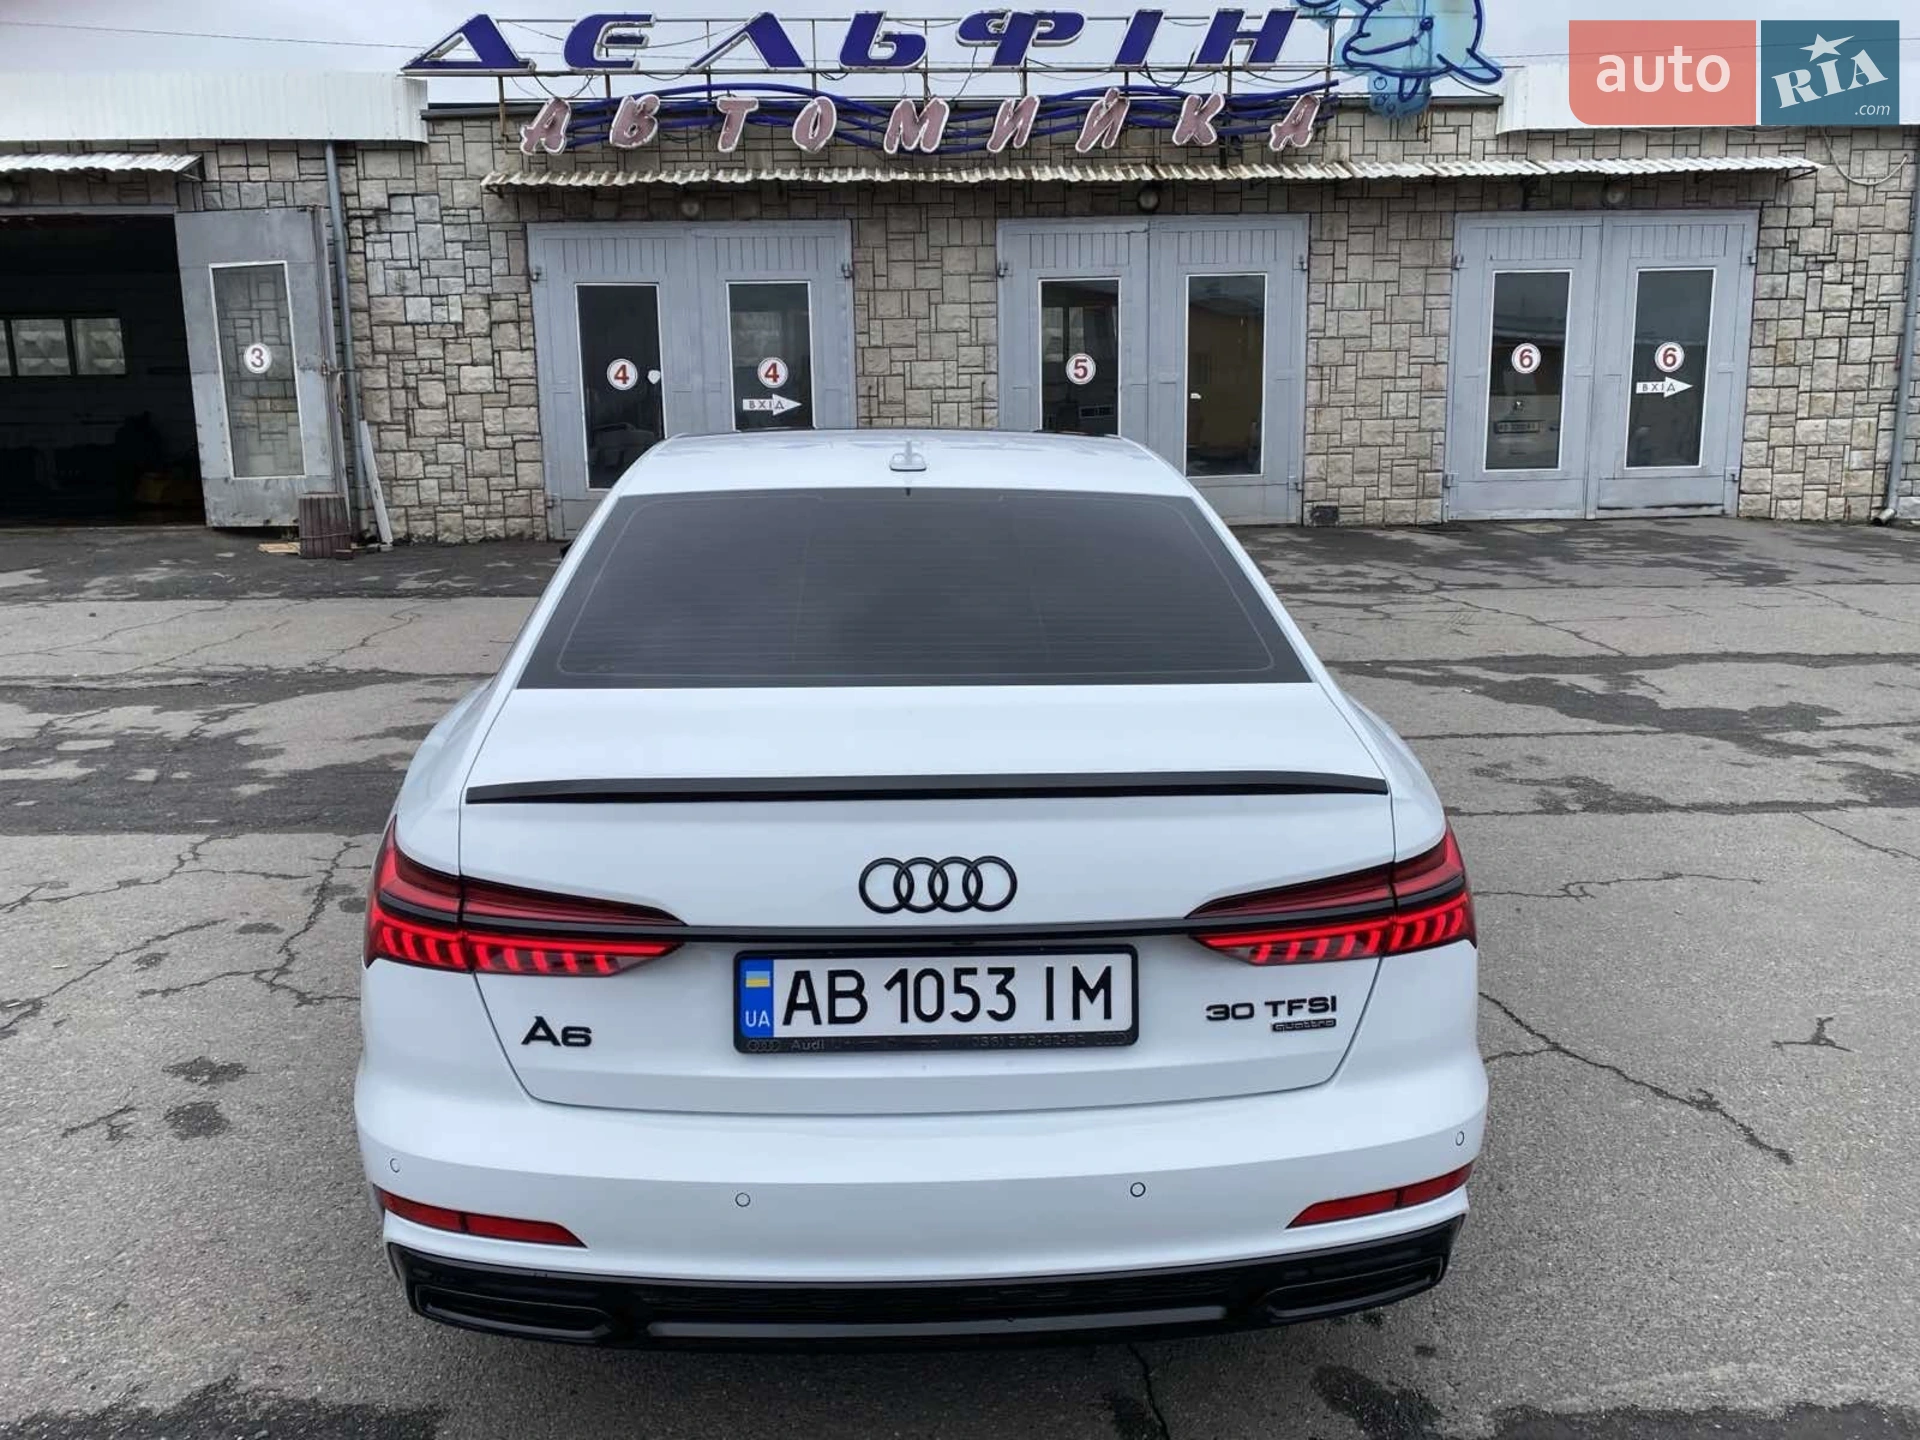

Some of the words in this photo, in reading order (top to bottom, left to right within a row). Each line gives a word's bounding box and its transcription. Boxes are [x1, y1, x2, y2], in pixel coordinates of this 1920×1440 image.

[401, 8, 1301, 73] ДЕЛЬФІН
[520, 87, 1319, 155] АВТОМИЙКА
[250, 347, 264, 368] 3
[1518, 348, 1533, 368] 6
[1662, 347, 1677, 367] 6
[613, 364, 630, 385] 4
[764, 362, 780, 383] 4
[1073, 358, 1088, 379] 5
[1642, 382, 1677, 393] ВХІД
[748, 399, 785, 410] ВХІД
[782, 970, 869, 1026] AB
[883, 966, 1016, 1024] 1053
[1045, 965, 1113, 1021] IM
[1205, 1002, 1255, 1021] 30
[1263, 995, 1337, 1018] TFSI
[745, 1010, 771, 1028] UA
[1274, 1019, 1336, 1032] quattro
[521, 1015, 592, 1047] A6
[790, 1038, 825, 1051] Audi
